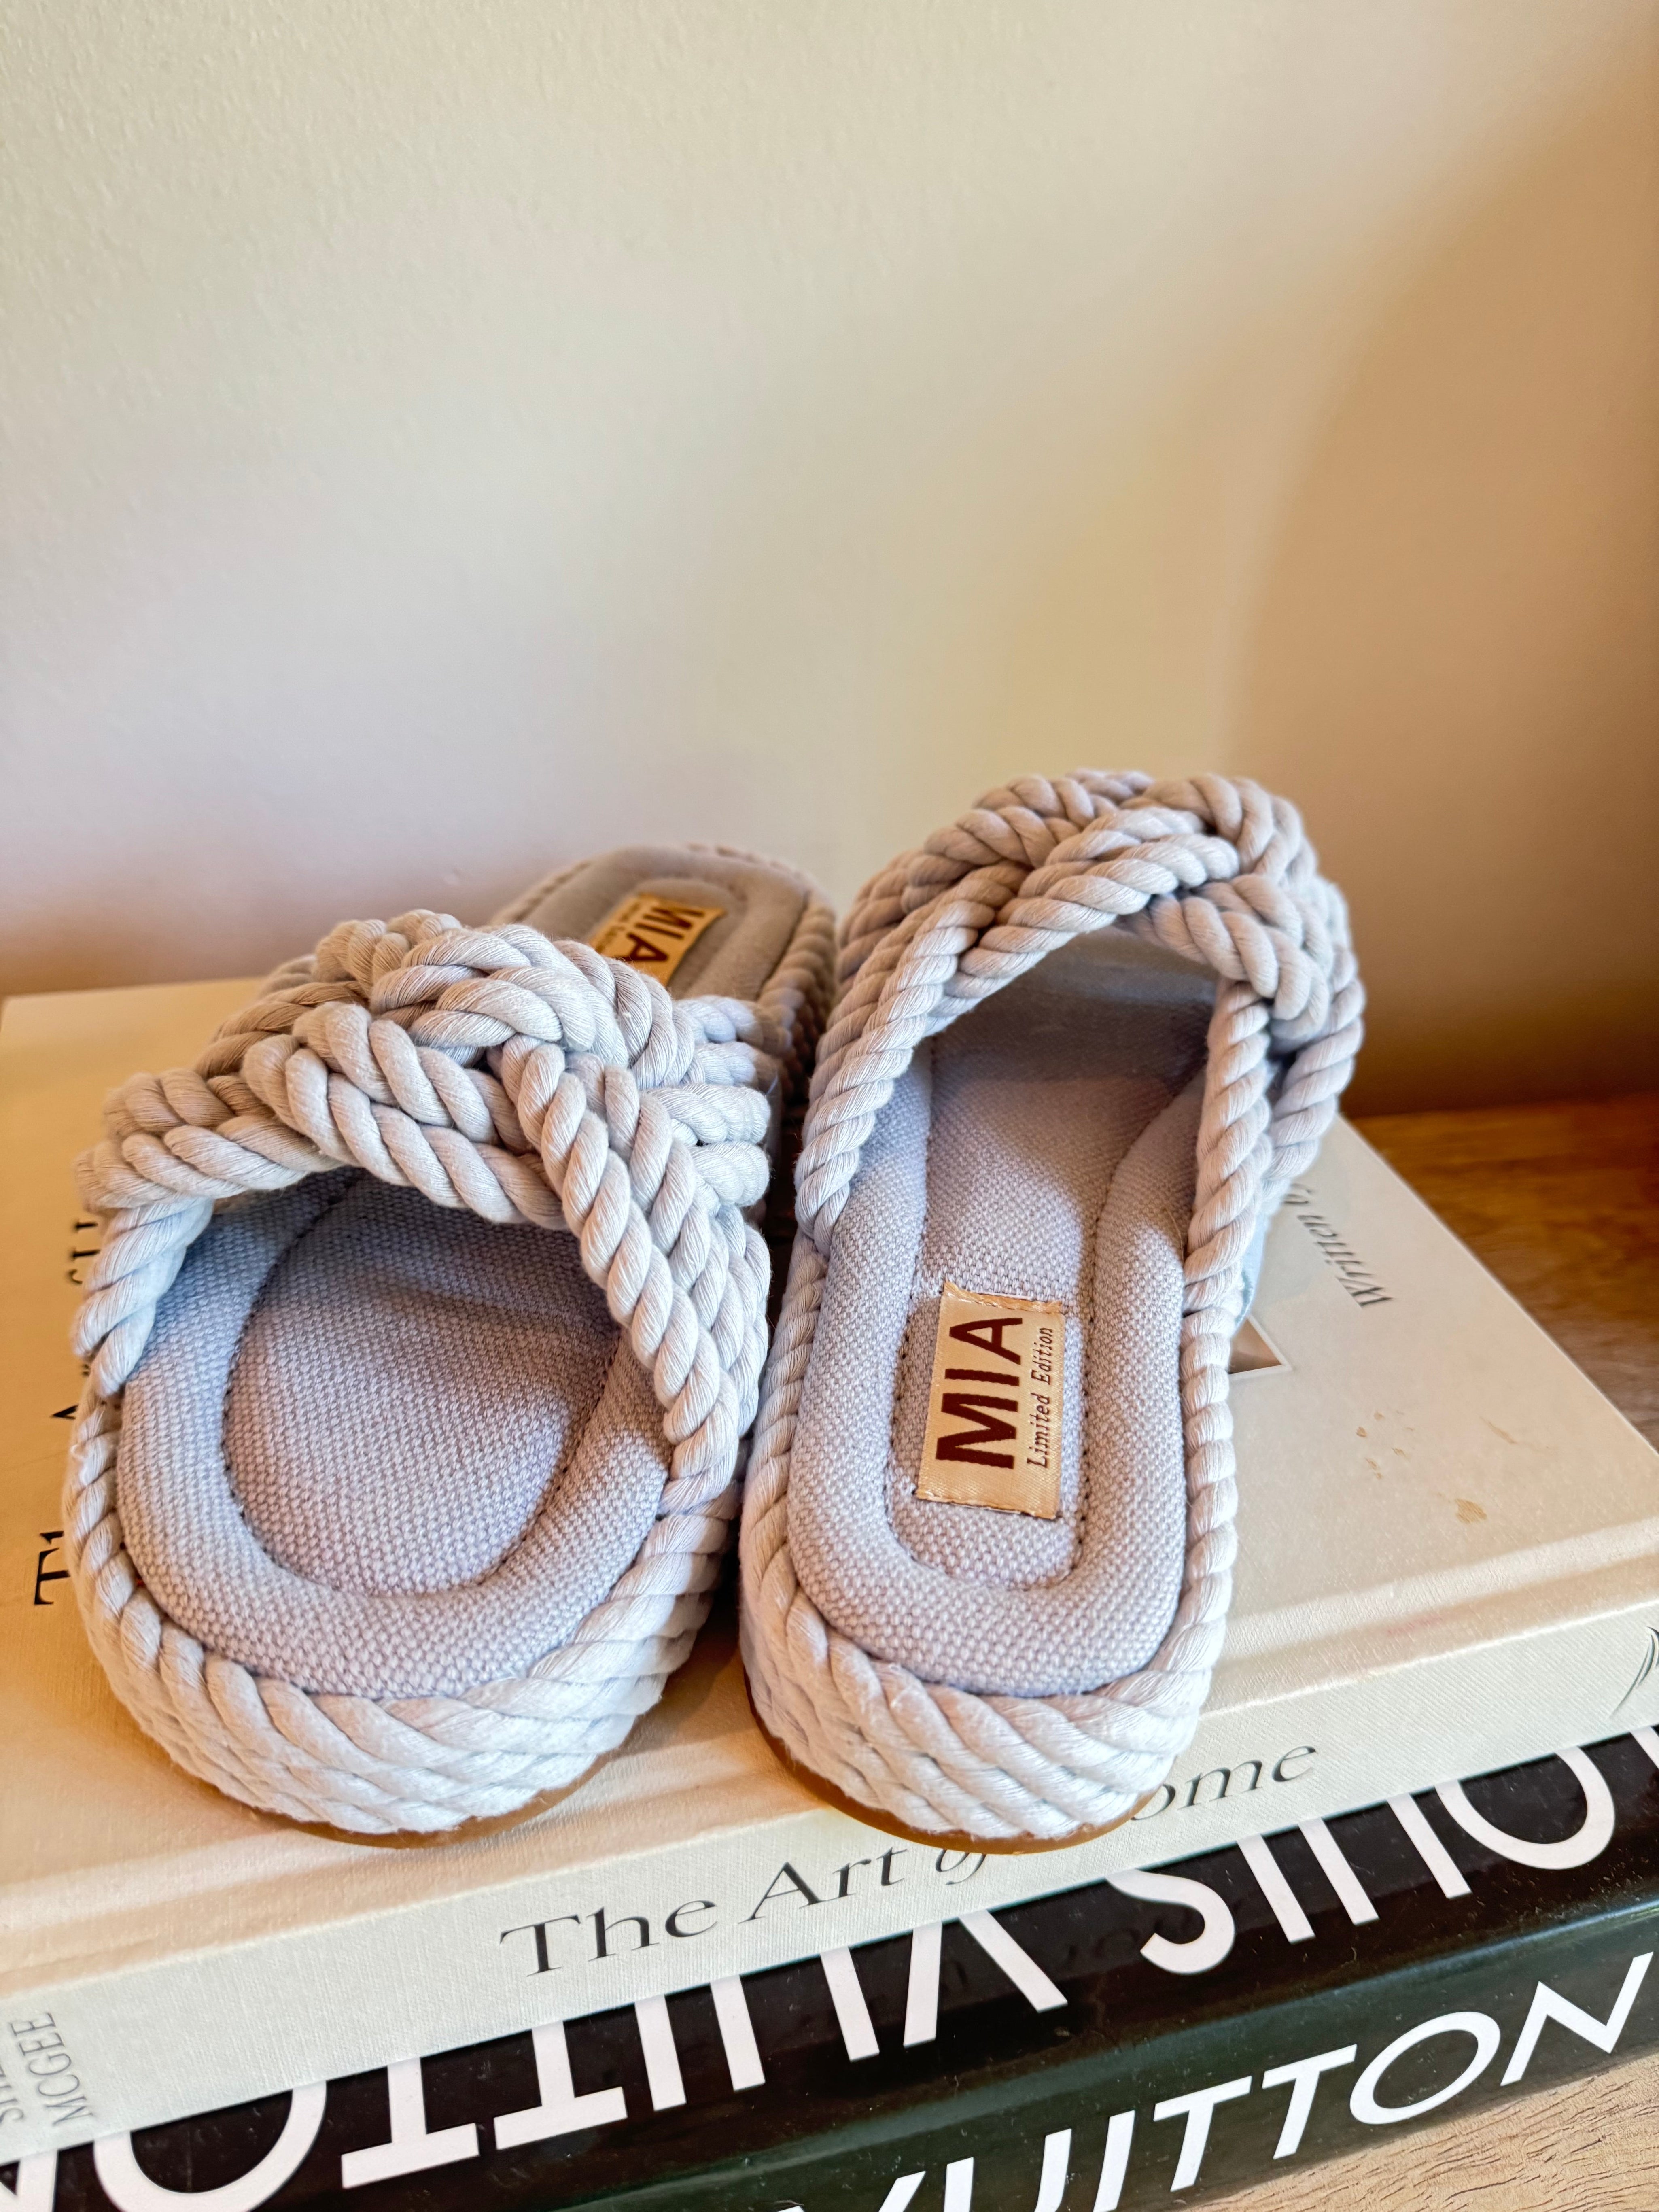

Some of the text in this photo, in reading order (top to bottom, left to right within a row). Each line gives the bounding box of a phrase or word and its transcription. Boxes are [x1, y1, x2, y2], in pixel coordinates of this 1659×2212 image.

[620, 906, 705, 962] MIA
[1297, 1215, 1393, 1307] Written
[935, 1317, 1023, 1469] MIA
[1027, 1327, 1053, 1469] Limited Edition
[500, 1900, 718, 1977] The
[738, 1847, 908, 1924] Art
[1131, 1745, 1318, 1821] ome
[1105, 1725, 1659, 1975] OUIS
[9, 2012, 93, 2126] MCGEE
